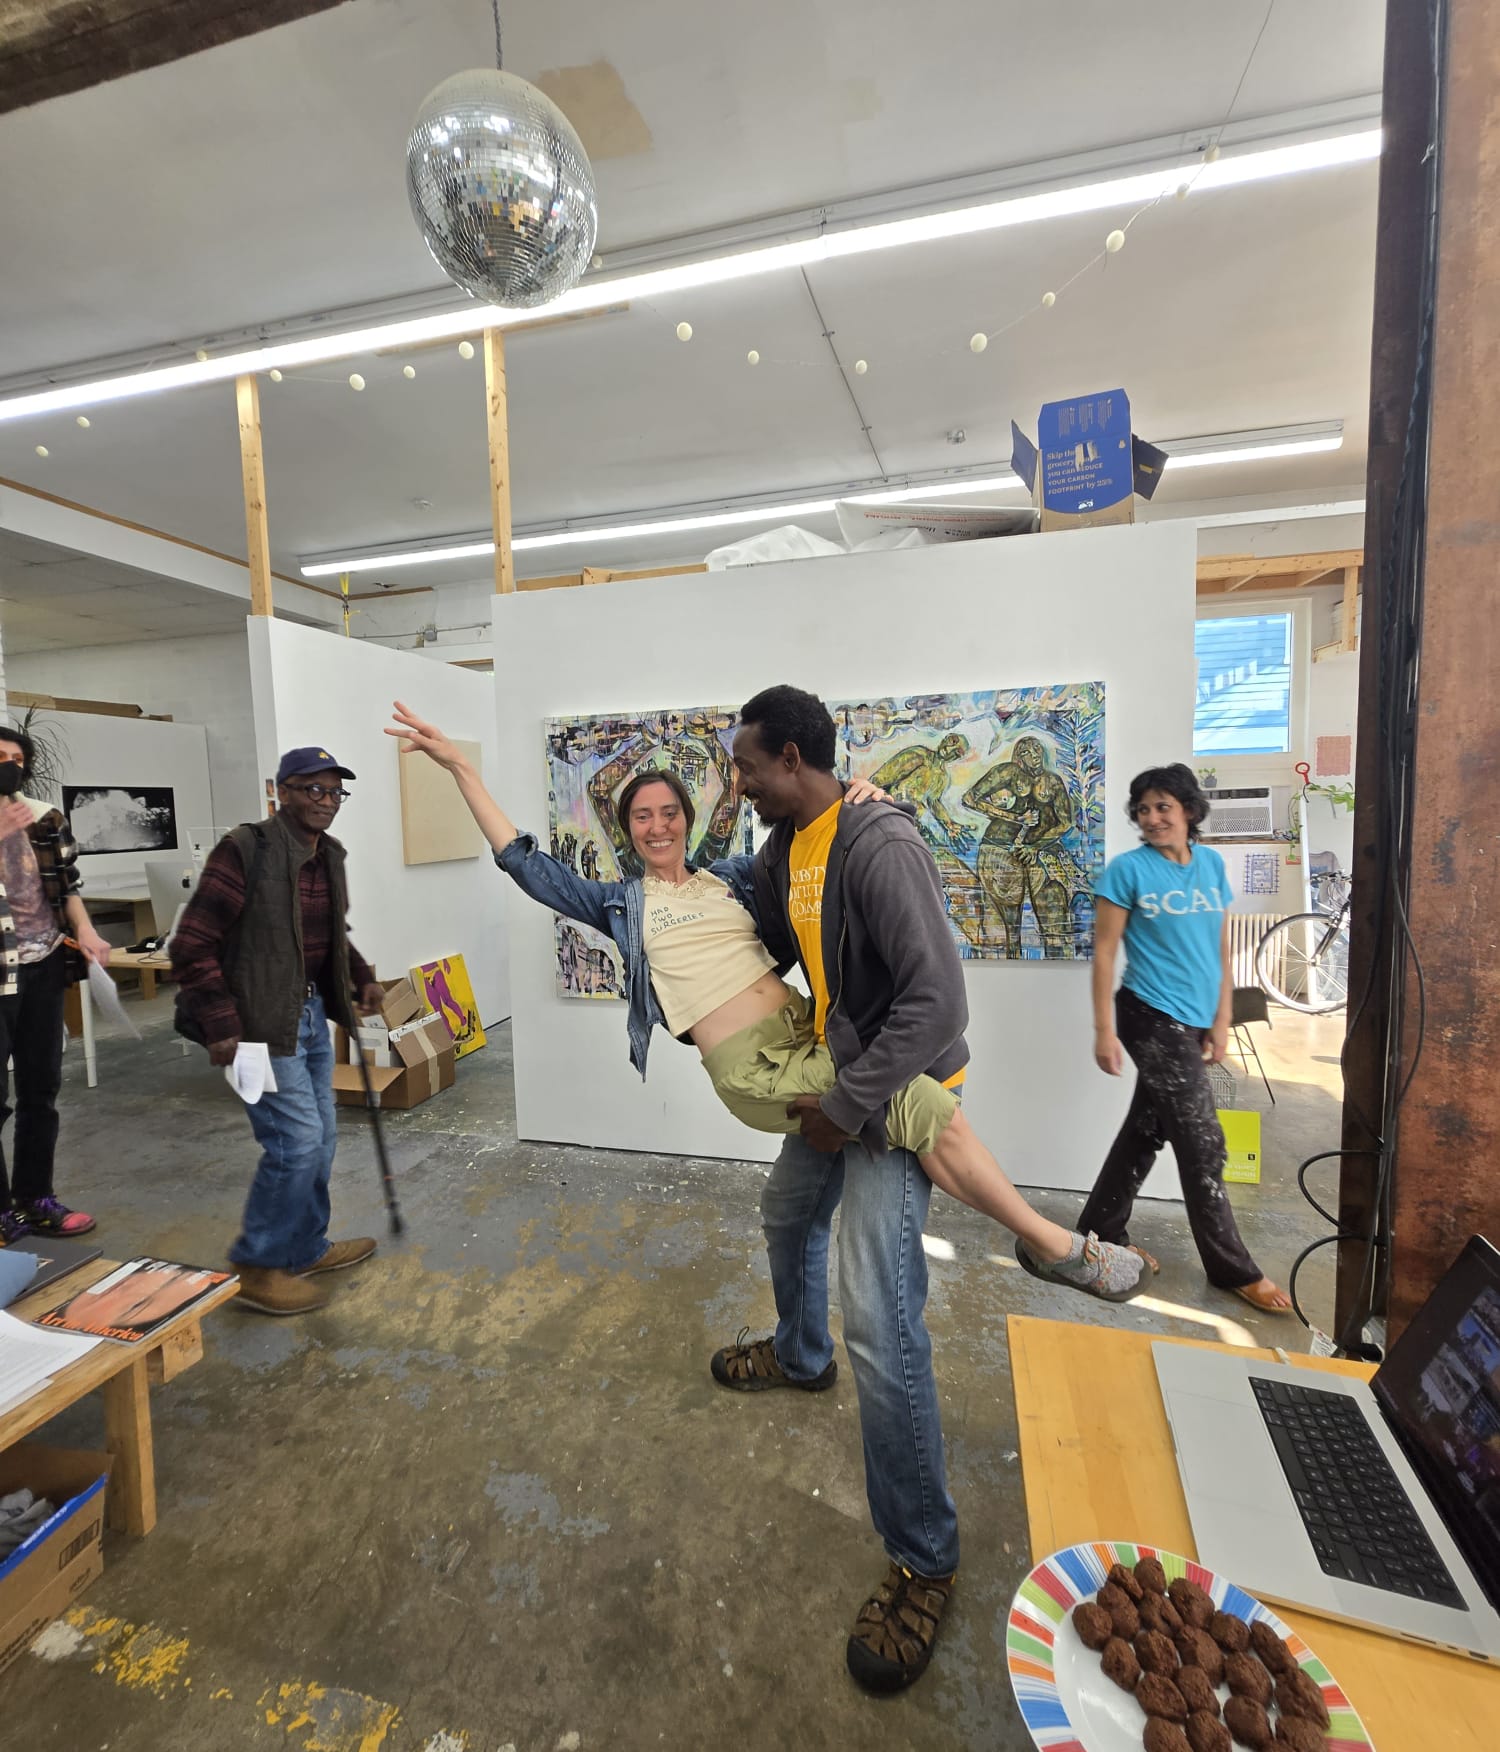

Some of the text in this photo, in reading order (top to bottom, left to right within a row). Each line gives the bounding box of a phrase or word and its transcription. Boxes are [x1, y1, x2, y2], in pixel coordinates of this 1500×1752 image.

[1047, 451, 1063, 460] Skip
[1047, 460, 1074, 470] grocery
[1047, 471, 1060, 479] you
[1062, 468, 1075, 476] can
[1048, 473, 1095, 486] YOUR CARBON
[1048, 484, 1085, 495] FOOTPRINT
[1086, 481, 1096, 490] by
[650, 906, 669, 917] HAD
[650, 911, 704, 936] SURGERIES
[652, 913, 672, 924] TWO
